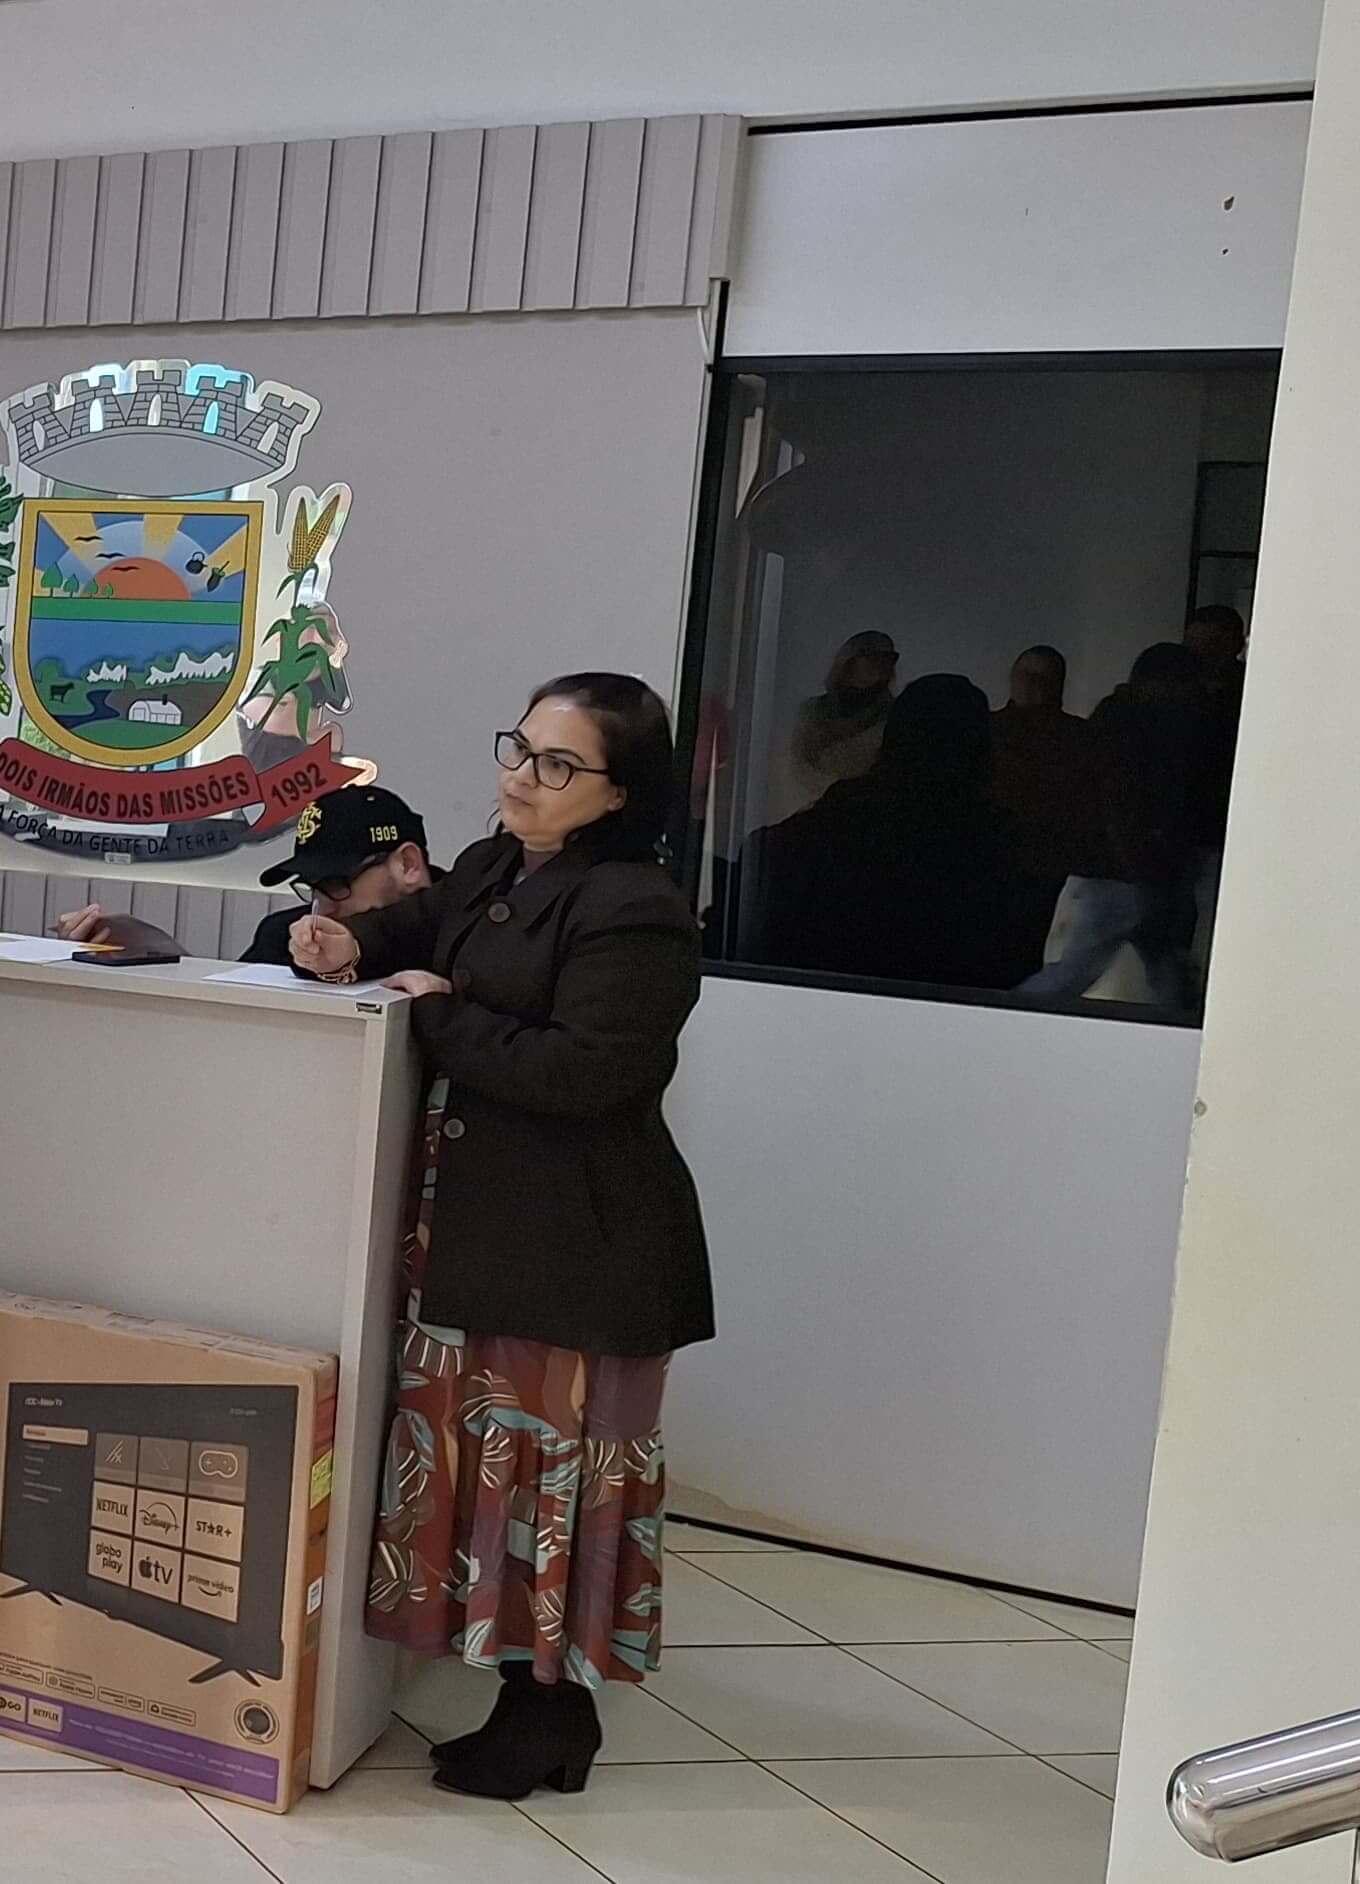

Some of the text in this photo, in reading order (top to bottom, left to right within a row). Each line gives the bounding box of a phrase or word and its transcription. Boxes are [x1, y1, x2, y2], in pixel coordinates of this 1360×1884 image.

[36, 775, 111, 817] IRMÃOS
[116, 793, 154, 819] DAS
[159, 770, 251, 817] MISSÕES
[270, 762, 328, 807] 1992
[7, 812, 58, 841] FORÇA
[62, 830, 84, 846] DA
[89, 835, 141, 854] GENTE
[146, 836, 169, 855] DA
[175, 831, 230, 851] TERRA
[369, 825, 399, 843] 1909
[95, 1498, 129, 1518] NETFLIX
[95, 1542, 123, 1559] globo
[102, 1556, 124, 1575] play
[153, 1560, 174, 1585] tv
[187, 1573, 235, 1594] prime video
